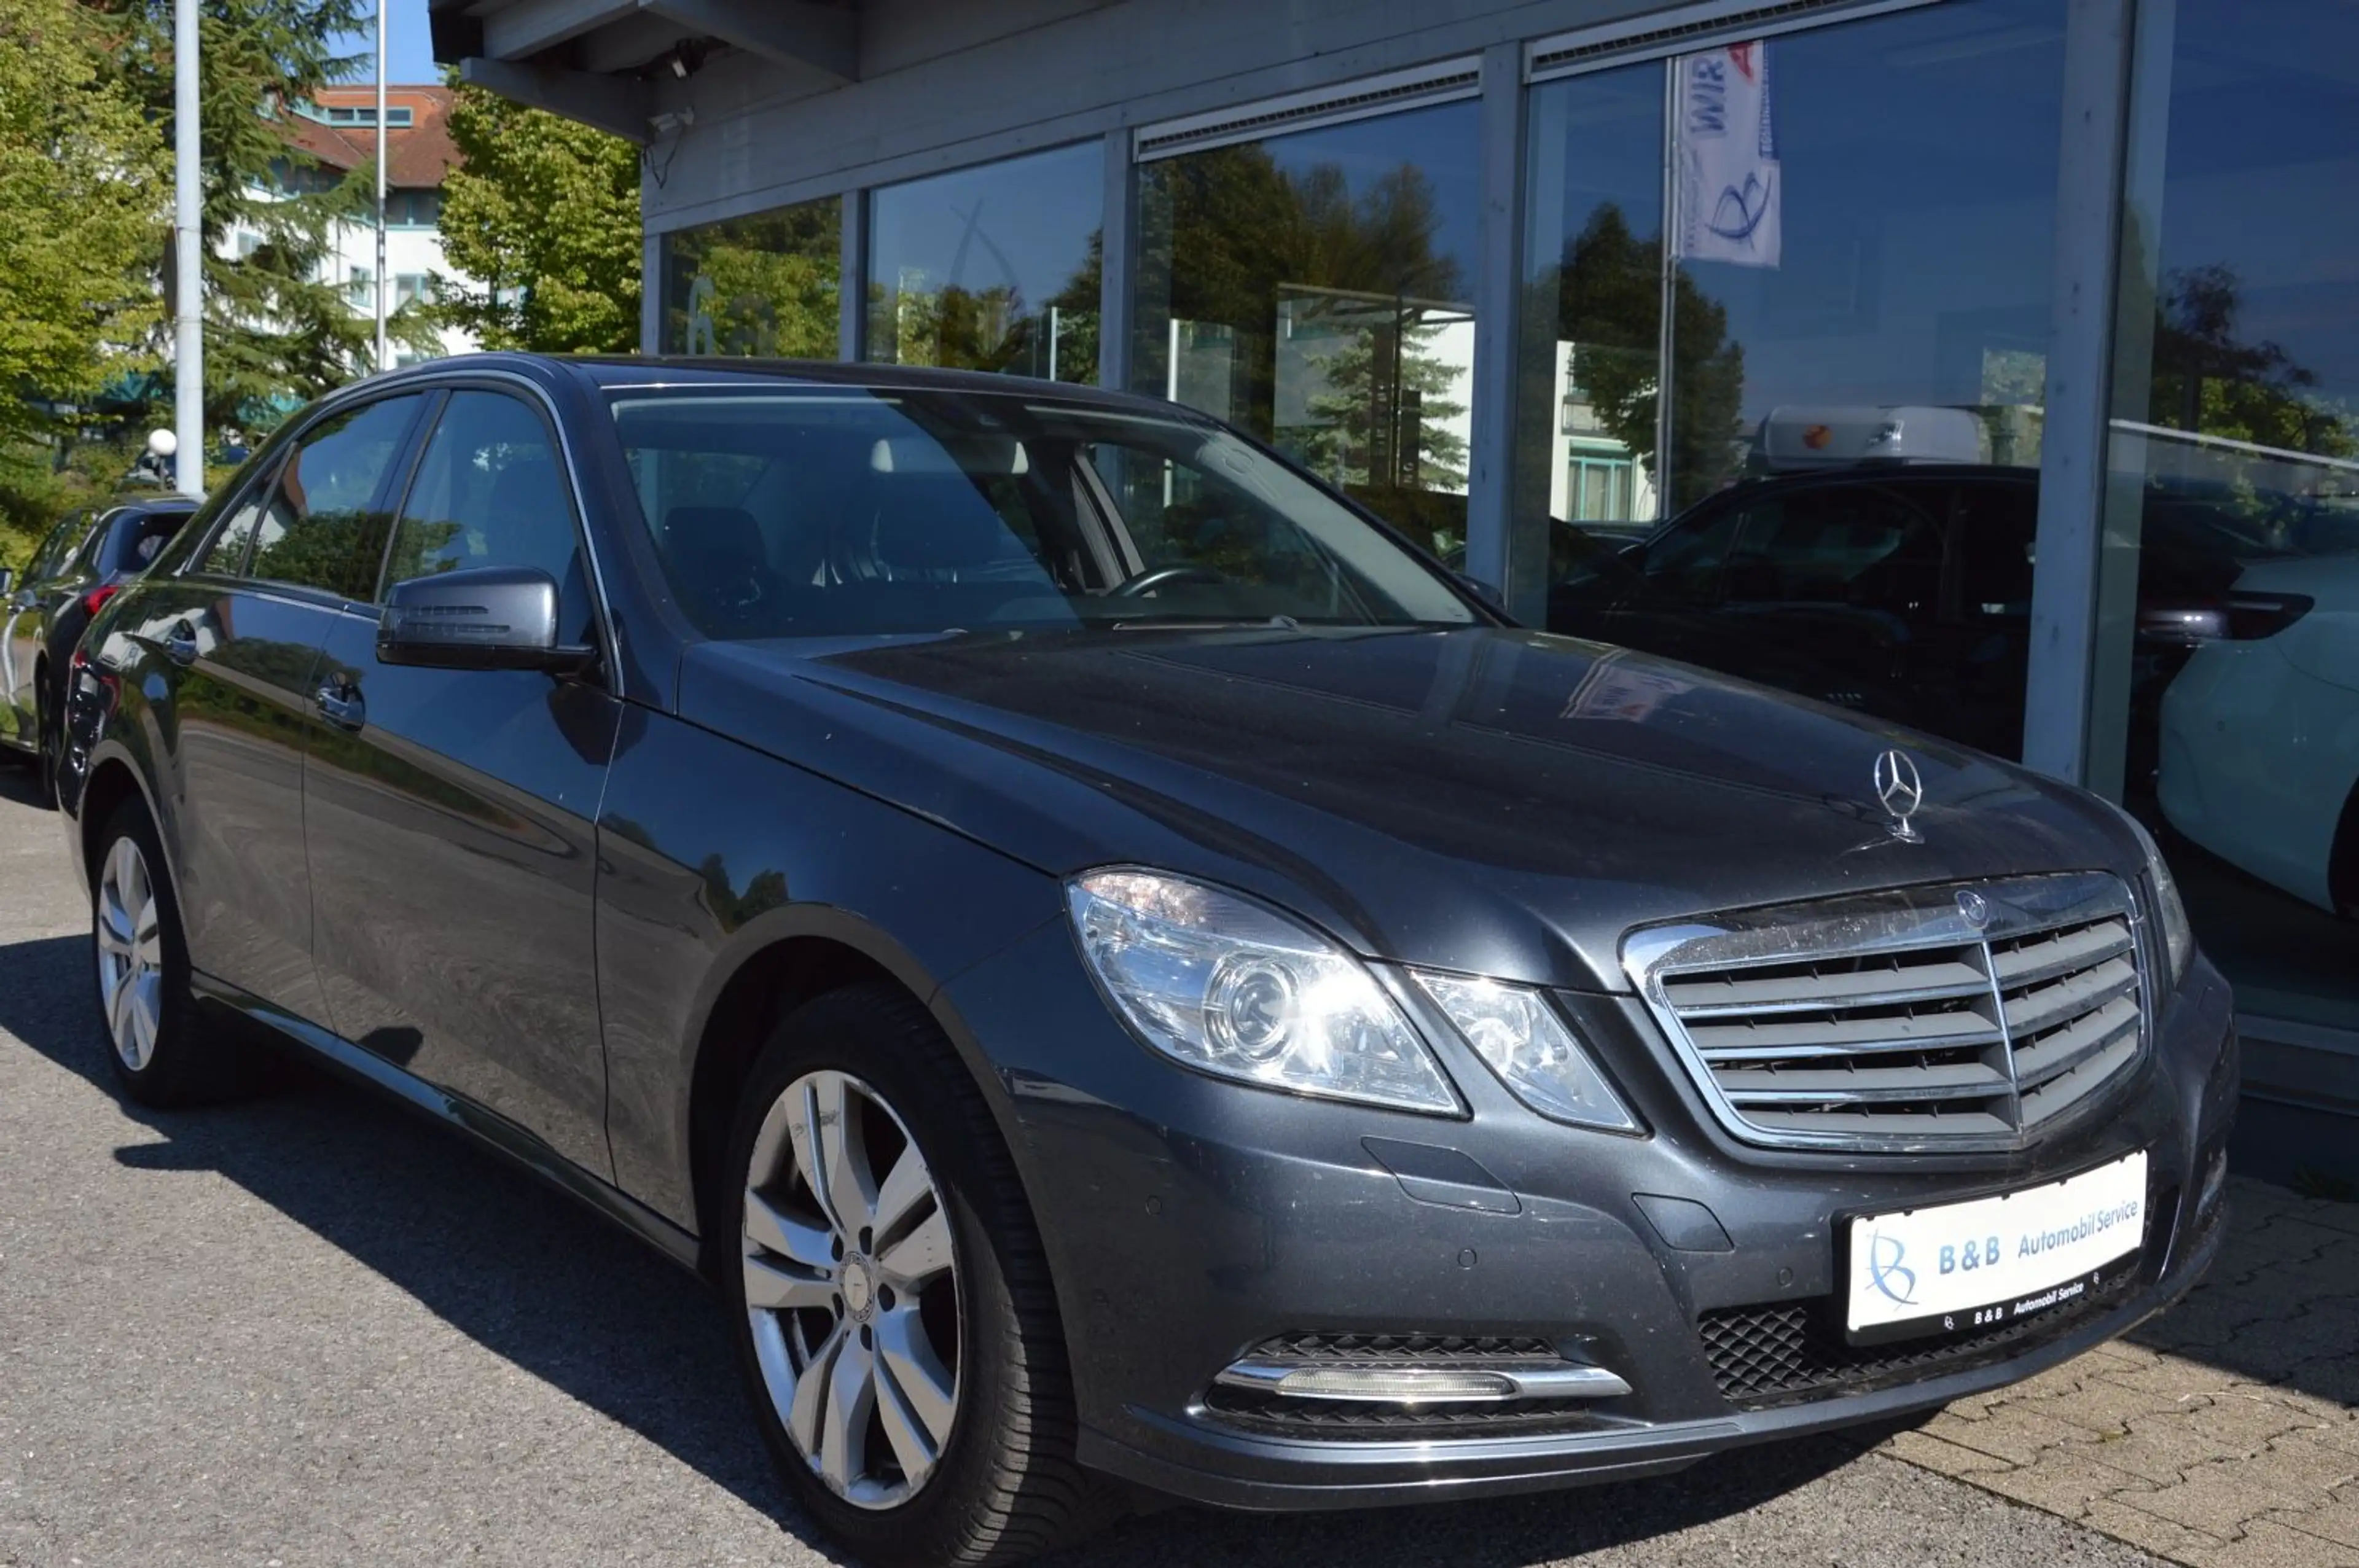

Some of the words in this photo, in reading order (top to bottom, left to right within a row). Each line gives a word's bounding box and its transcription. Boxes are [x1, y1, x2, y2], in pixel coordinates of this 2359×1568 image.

[1939, 1244, 1955, 1275] B
[1961, 1239, 1980, 1271] &
[1985, 1235, 2000, 1265] B
[2017, 1212, 2095, 1258] Automobil
[2097, 1200, 2138, 1233] Service
[1974, 1311, 1982, 1324] B
[1984, 1309, 1993, 1322] &
[1995, 1306, 2003, 1320] B
[2013, 1290, 2058, 1316] Automobil
[2058, 1282, 2084, 1301] Service
